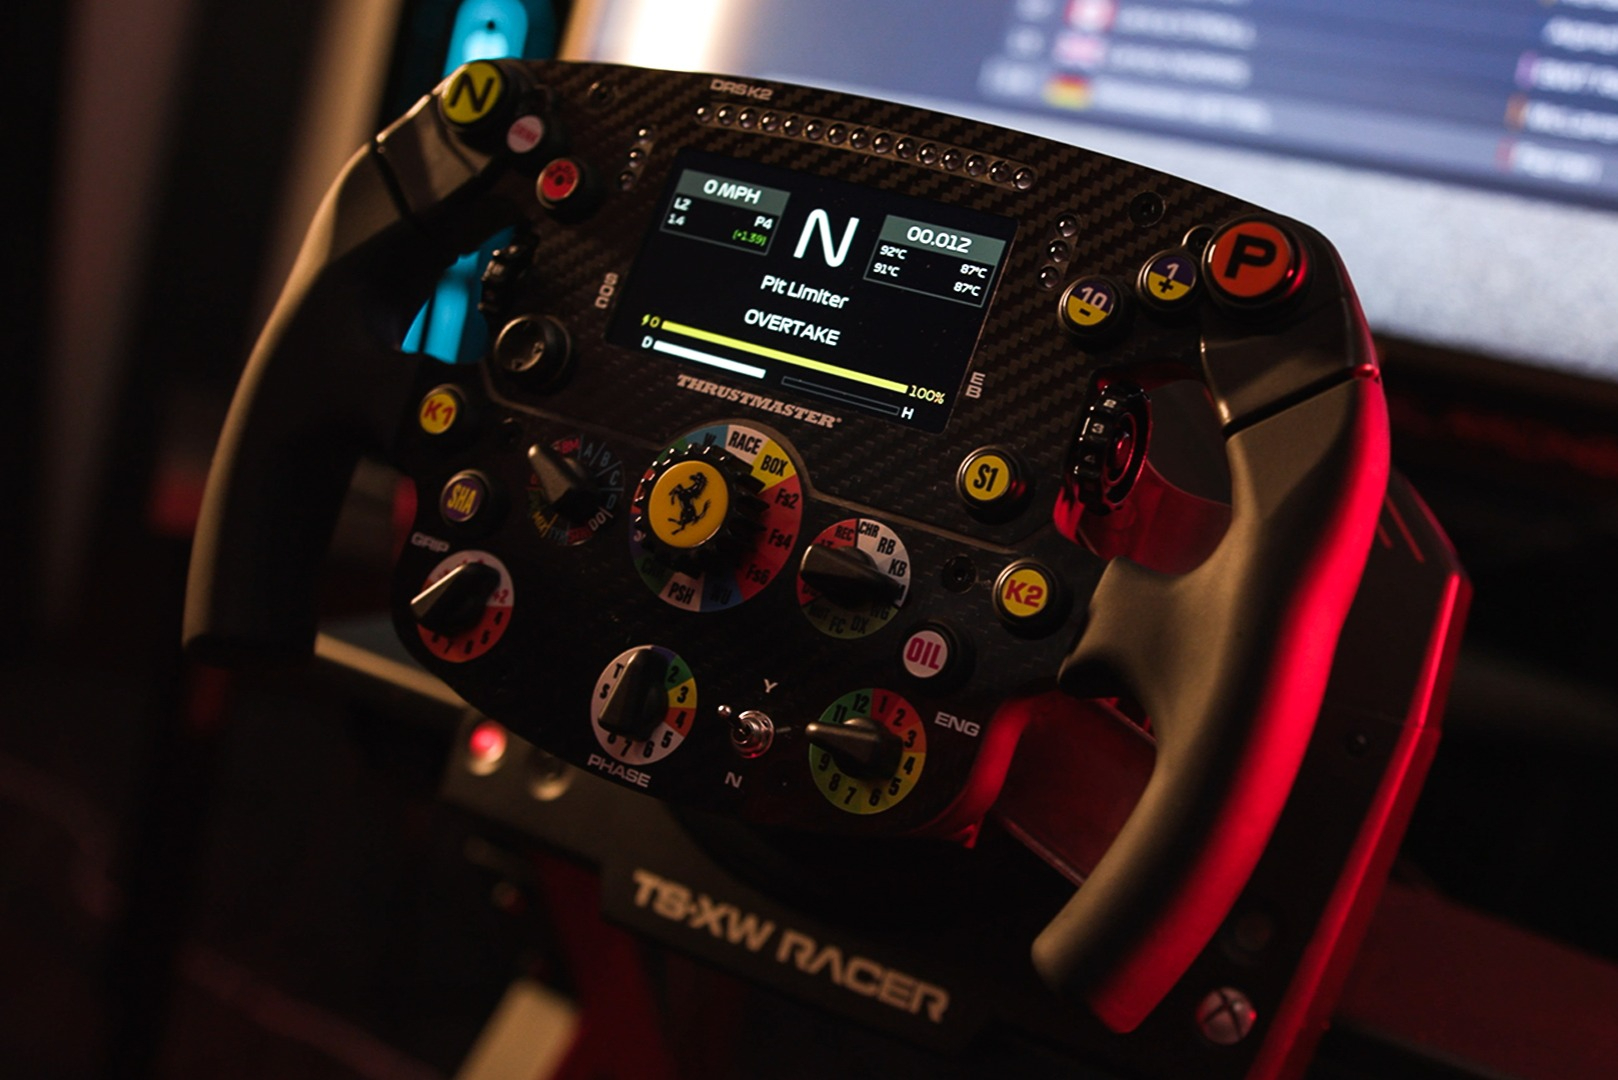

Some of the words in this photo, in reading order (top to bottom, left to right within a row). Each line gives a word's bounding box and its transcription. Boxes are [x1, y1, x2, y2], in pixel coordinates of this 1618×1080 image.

[449, 73, 496, 113] N
[747, 86, 774, 101] K2
[703, 179, 718, 195] 0
[717, 182, 762, 204] MPH
[754, 215, 774, 230] P4
[793, 208, 860, 268] N
[906, 225, 973, 254] 00.012
[1224, 234, 1277, 281] P
[1165, 262, 1180, 280] 1
[760, 275, 787, 294] Pit
[787, 281, 850, 309] Limiter
[1080, 285, 1108, 310] 10
[744, 308, 841, 346] OVERTAKE
[676, 374, 841, 428] THRUSTMASTER
[909, 384, 946, 405] 100%
[423, 401, 453, 426] K1
[901, 406, 914, 420] H
[728, 431, 762, 455] RACE
[761, 455, 788, 477] BOX
[973, 463, 999, 492] S1
[447, 482, 477, 515] SHA
[835, 525, 854, 541] REC
[859, 521, 880, 538] CHR
[877, 537, 896, 555] RB
[888, 559, 908, 577] KB
[668, 582, 695, 605] PSH
[1005, 578, 1044, 608] K2
[906, 637, 942, 670] OIL
[668, 666, 679, 684] 2
[677, 686, 689, 703] 3
[762, 677, 779, 694] Y
[832, 704, 847, 723] 11
[852, 694, 870, 714] 12
[878, 696, 888, 713] 1
[675, 711, 687, 728] 4
[893, 709, 905, 726] 2
[934, 711, 981, 738] ENG
[661, 731, 673, 749] 5
[905, 730, 917, 748] 3
[586, 753, 651, 788] PHASE
[818, 754, 831, 771] 9
[903, 757, 915, 774] 4
[724, 770, 743, 789] N
[828, 773, 841, 791] 8
[888, 778, 902, 796] 5
[844, 787, 856, 804] 7
[869, 788, 881, 806] 6
[775, 928, 951, 1024] RACER
